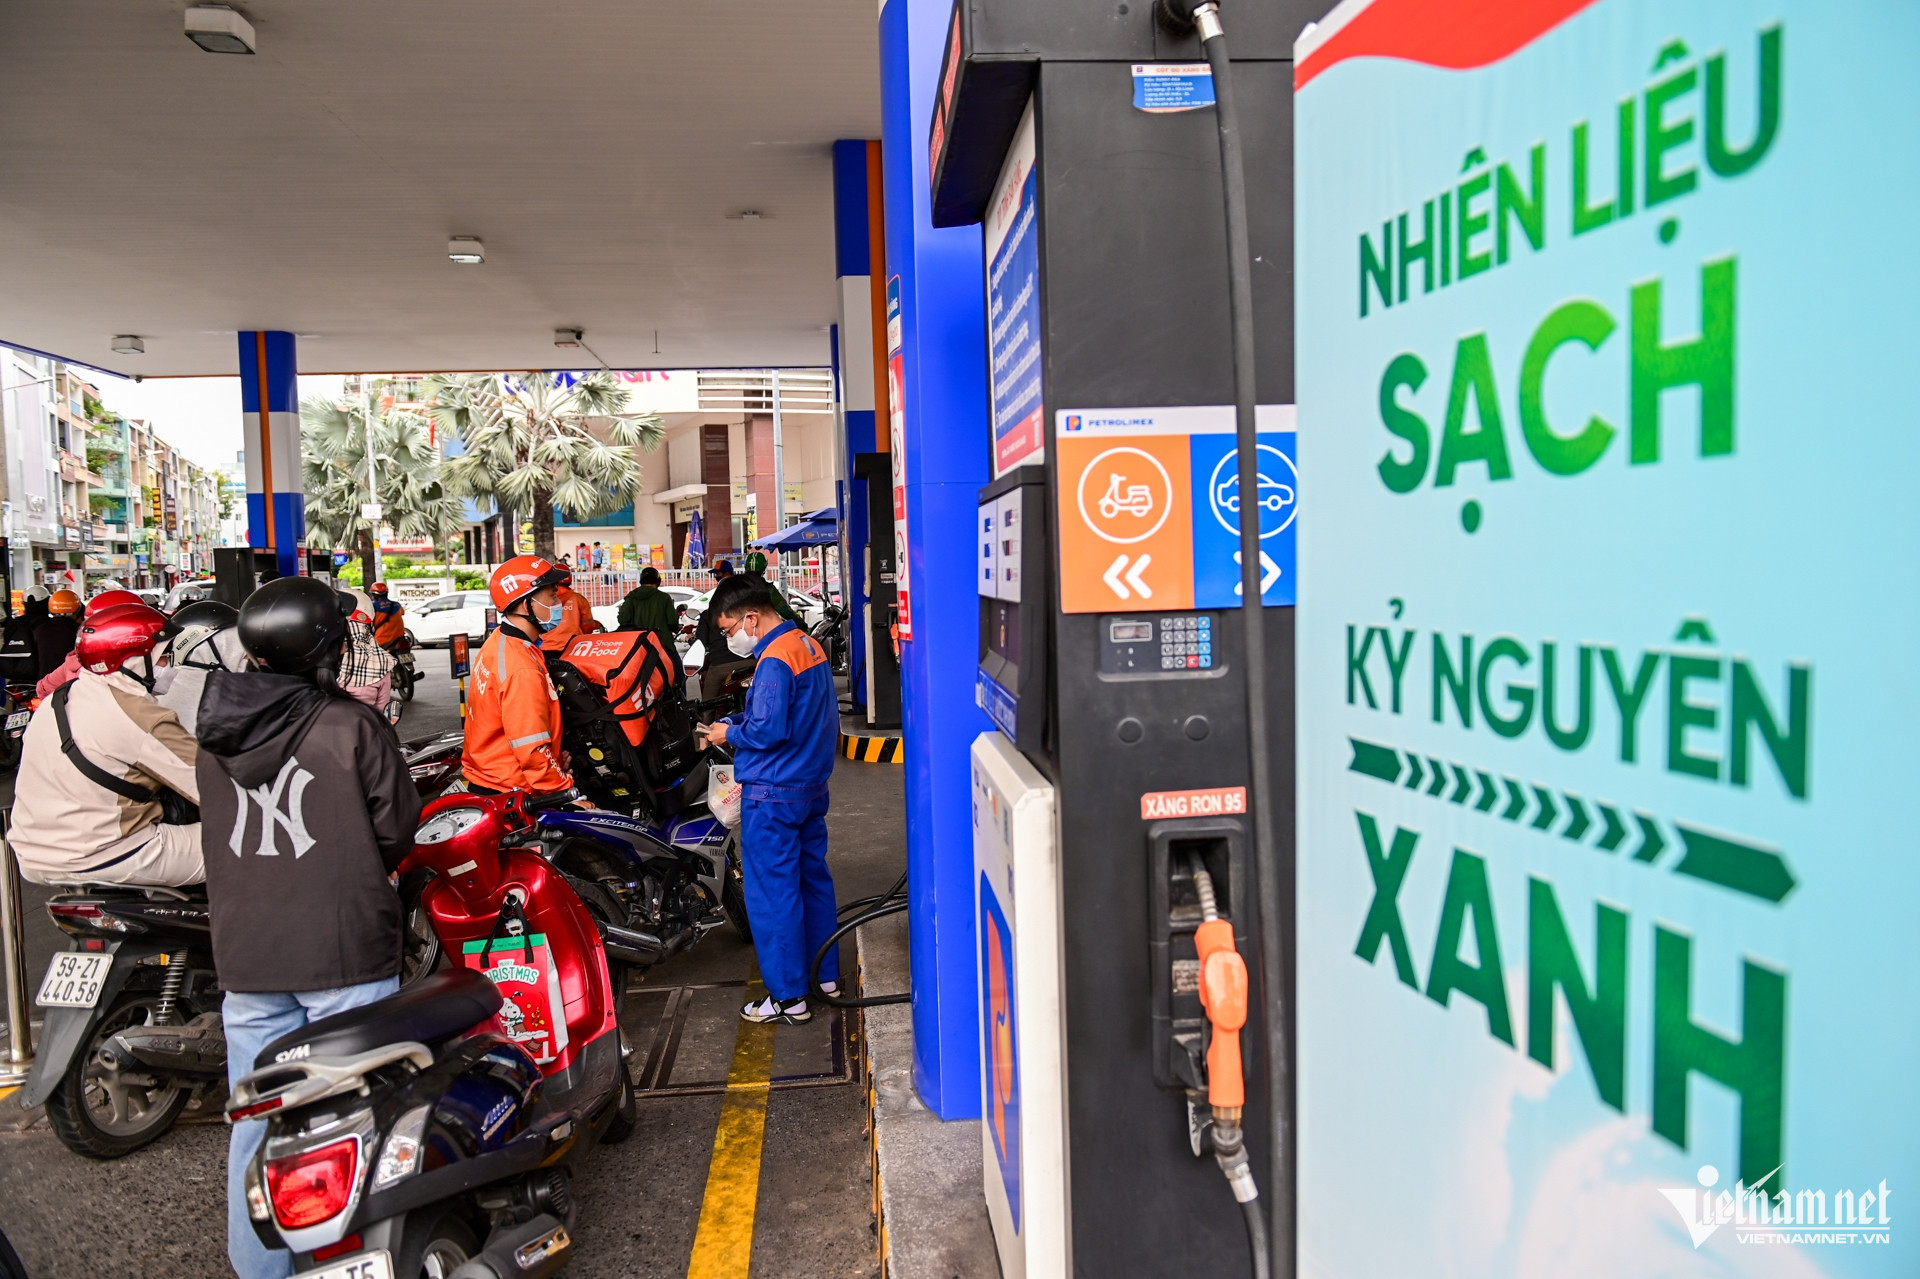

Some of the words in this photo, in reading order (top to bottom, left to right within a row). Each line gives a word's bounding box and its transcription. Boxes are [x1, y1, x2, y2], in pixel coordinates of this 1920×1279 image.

[1359, 145, 1545, 319] NHIÊN
[1571, 20, 1782, 245] LIỆU
[1377, 252, 1738, 534] SẠCH
[1089, 418, 1154, 427] PETROLIMEX
[588, 647, 620, 657] Food
[595, 640, 623, 648] Shopee
[1347, 596, 1416, 717] KỶ
[1432, 614, 1814, 804] NGUYÊN
[1145, 795, 1188, 817] XĂNG
[1190, 795, 1222, 813] RON
[1224, 793, 1242, 811] 95
[57, 957, 101, 979] 59-Z1
[43, 979, 98, 1003] 440.58
[1353, 807, 1790, 1207] XANH
[275, 1044, 310, 1062] SYM
